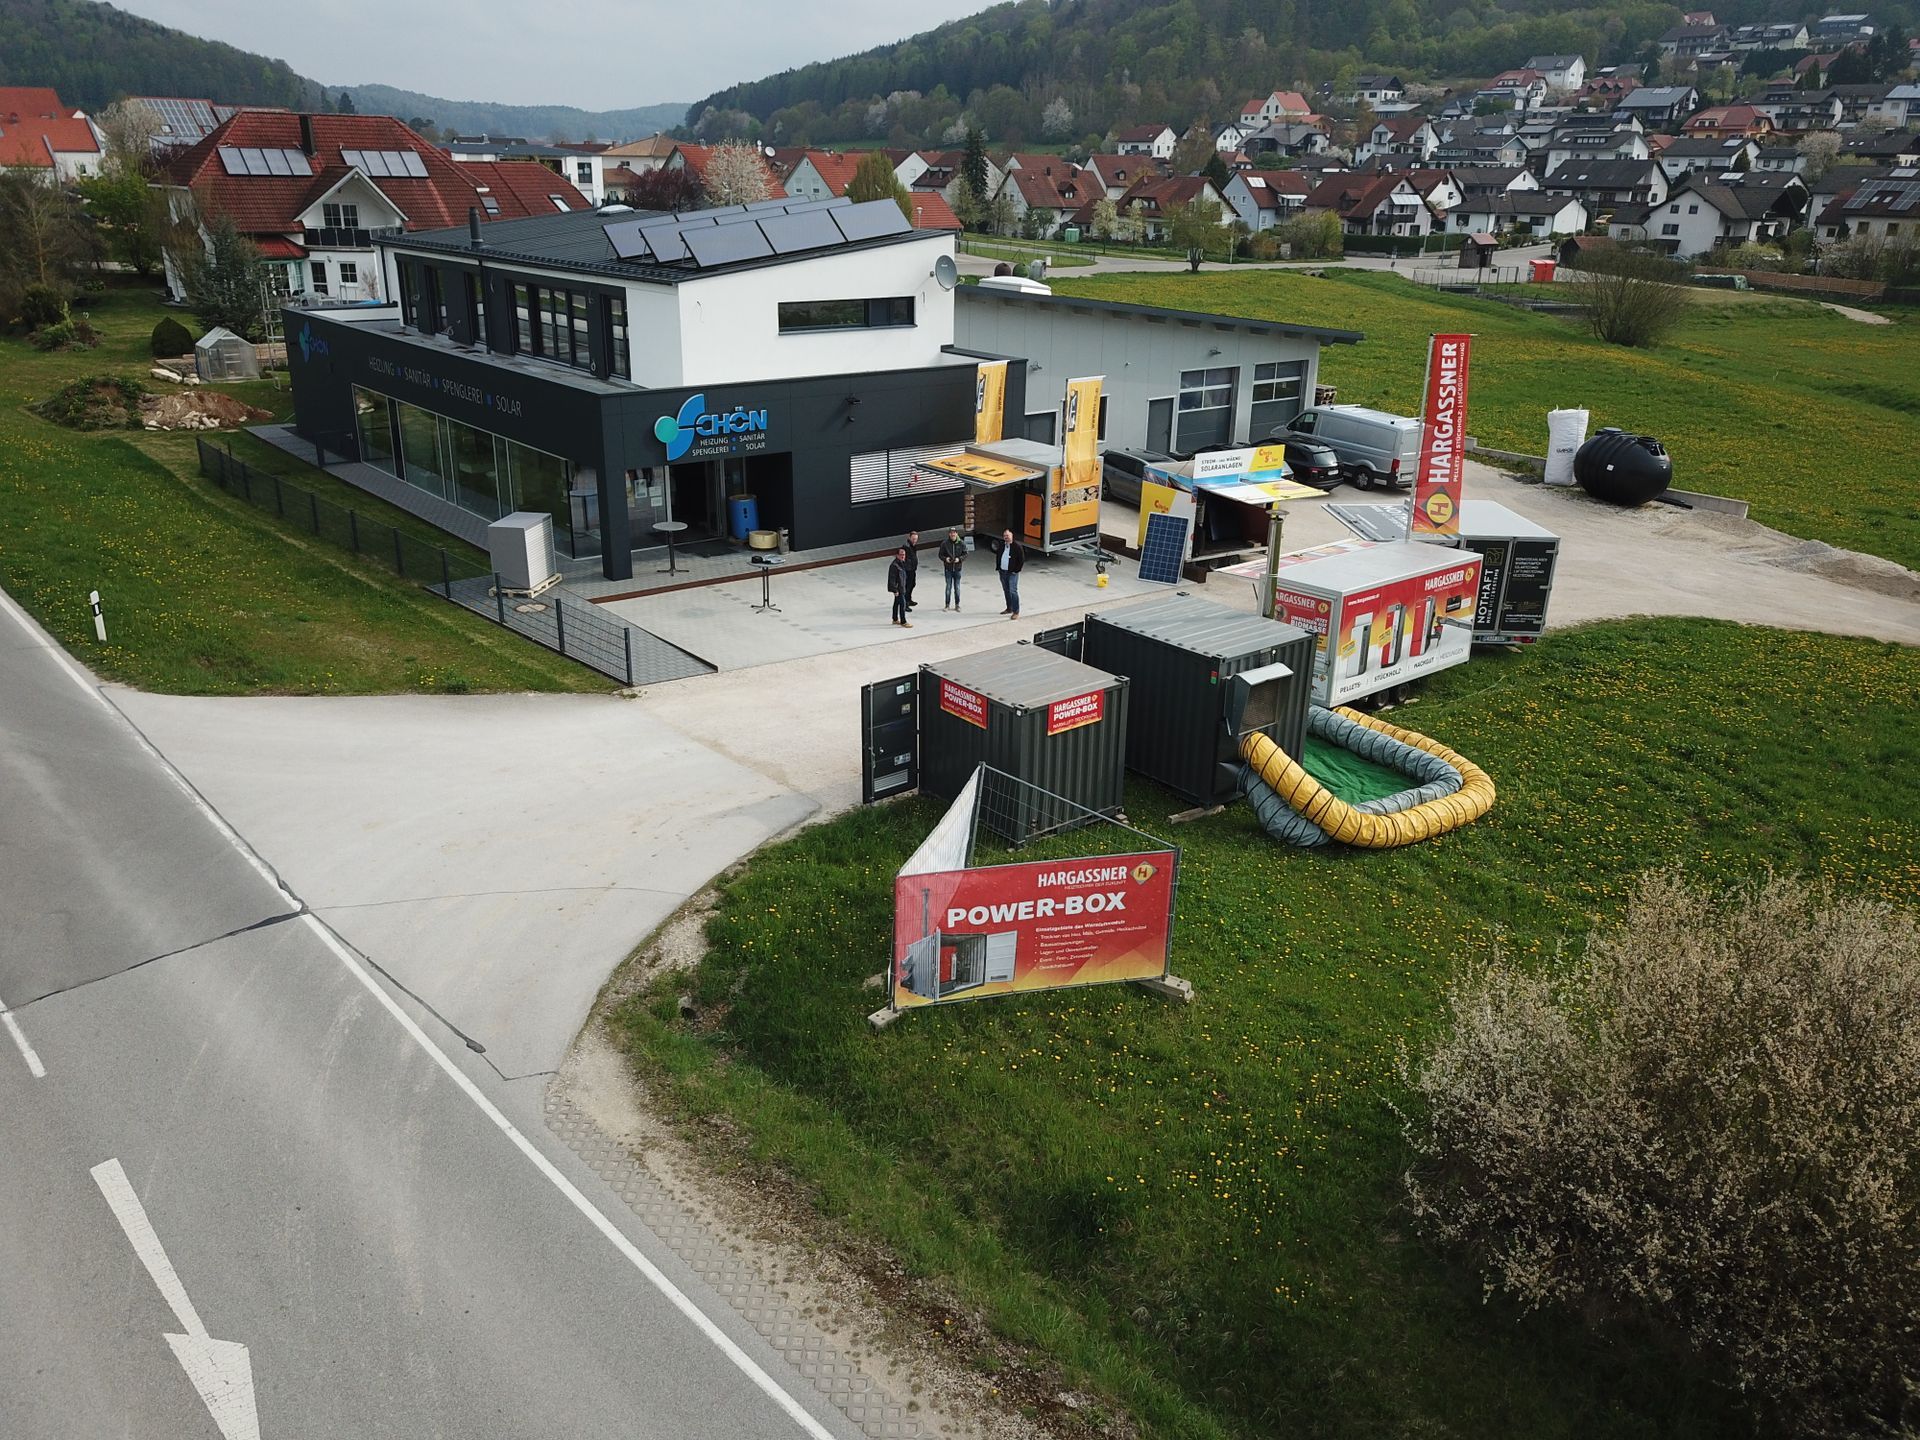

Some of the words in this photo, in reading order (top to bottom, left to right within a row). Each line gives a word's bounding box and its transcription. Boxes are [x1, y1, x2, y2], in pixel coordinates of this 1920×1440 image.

[368, 356, 395, 376] HEIZUNG
[404, 366, 431, 388] SANITÄR
[442, 378, 483, 405] SPENGLEREI
[495, 395, 522, 417] SOLAR
[1428, 343, 1458, 483] HARGASSNER
[692, 446, 729, 457] SPENGLEREI
[745, 442, 766, 451] SOLAR
[700, 437, 729, 447] HEIZUNG
[739, 432, 765, 443] SANITÄR
[1201, 462, 1243, 472] SOLARANLAGEN
[1424, 570, 1465, 591] HARGASSNER
[1477, 569, 1494, 624] NOTHAFT
[944, 683, 977, 703] HARGASSNER
[944, 690, 983, 715] POWER-BOX
[1053, 702, 1098, 722] POWER-BOX
[1054, 696, 1092, 713] HARGASSNER
[1037, 866, 1128, 888] HARGASSNER
[947, 891, 1127, 928] POWER-BOX
